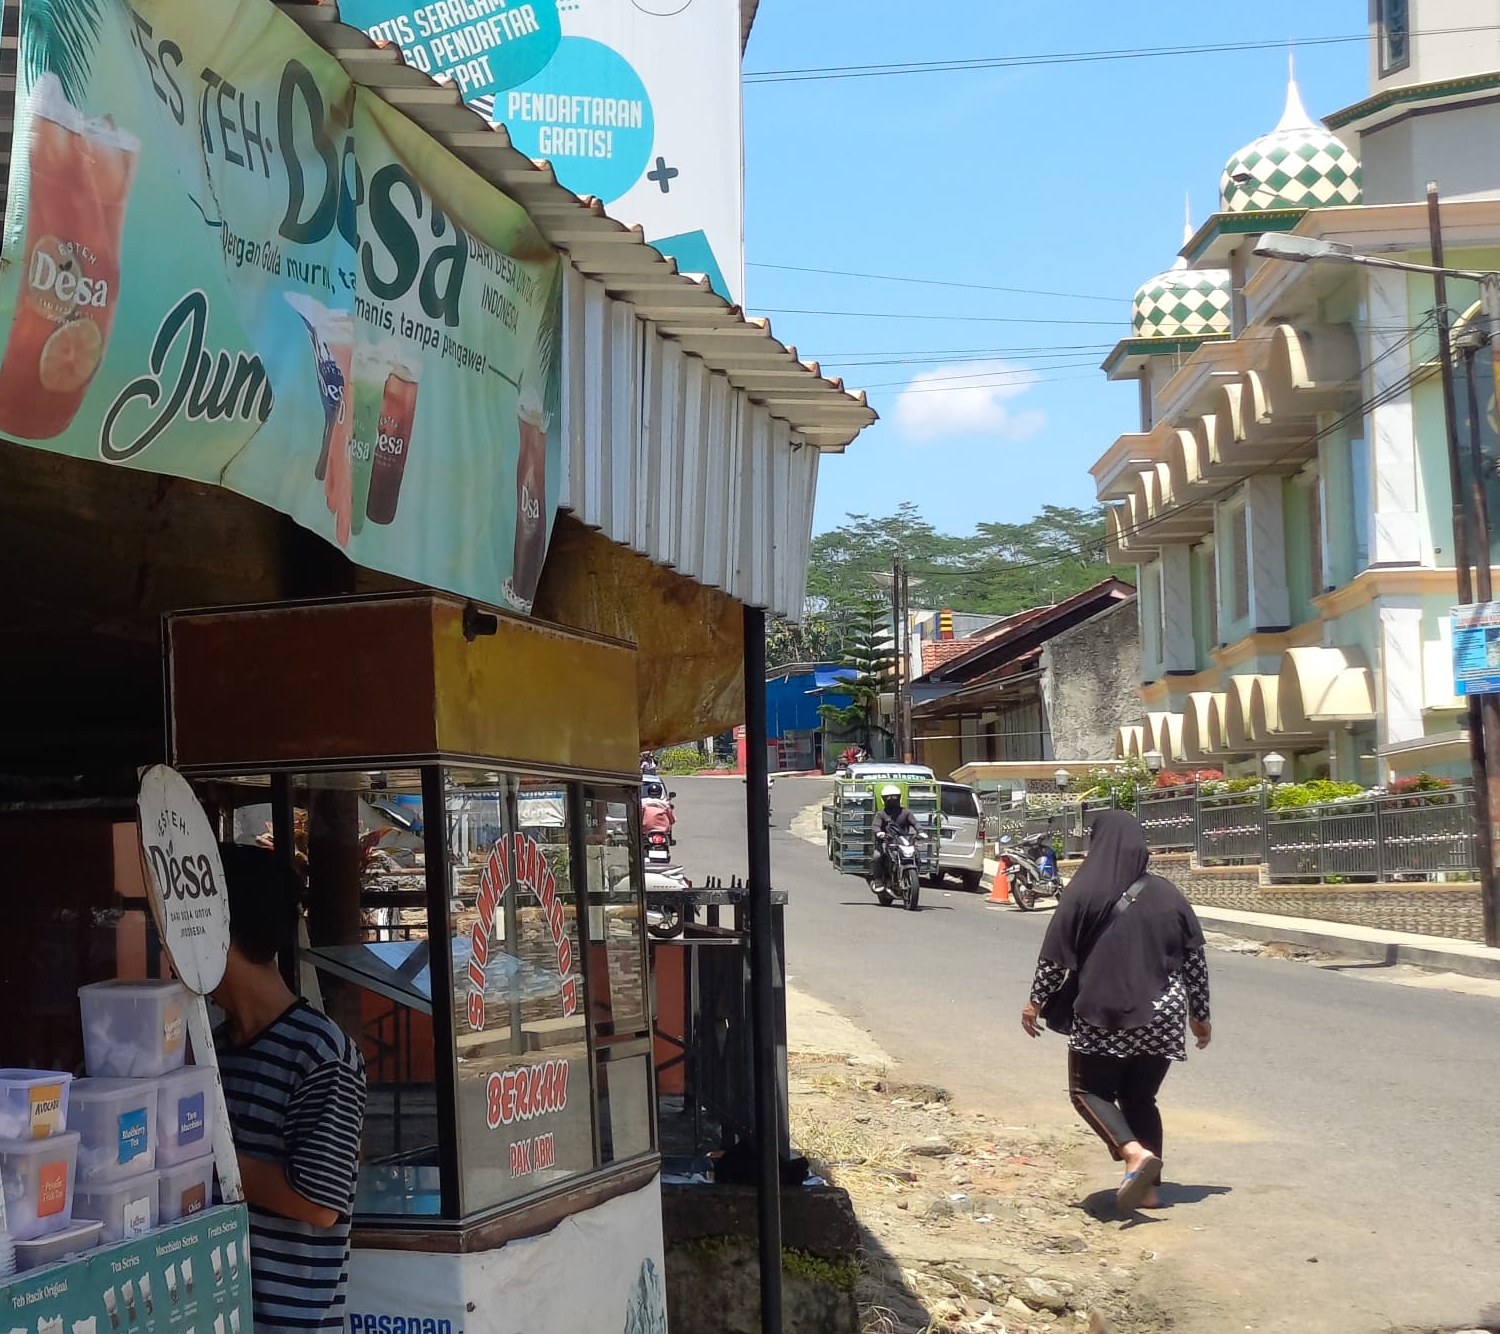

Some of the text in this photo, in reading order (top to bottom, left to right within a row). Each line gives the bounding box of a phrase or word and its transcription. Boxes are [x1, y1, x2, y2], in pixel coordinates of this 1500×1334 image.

[364, 15, 416, 47] ATIS
[429, 4, 540, 68] PENDAFTAR
[200, 67, 270, 179] TEH
[508, 92, 642, 129] PENDAFTARAN
[538, 126, 612, 159] GRATIS!
[31, 250, 108, 307] Desa
[355, 295, 396, 336] manis,
[400, 312, 441, 350] tanpa
[441, 334, 487, 375] pengawet
[149, 844, 218, 901] Desa
[468, 832, 577, 1031] SIOMAY BATAGOR
[487, 1058, 569, 1130] BERKAH
[509, 1132, 555, 1179] PAK ABRI
[11, 1279, 69, 1309] Teh Racik Original
